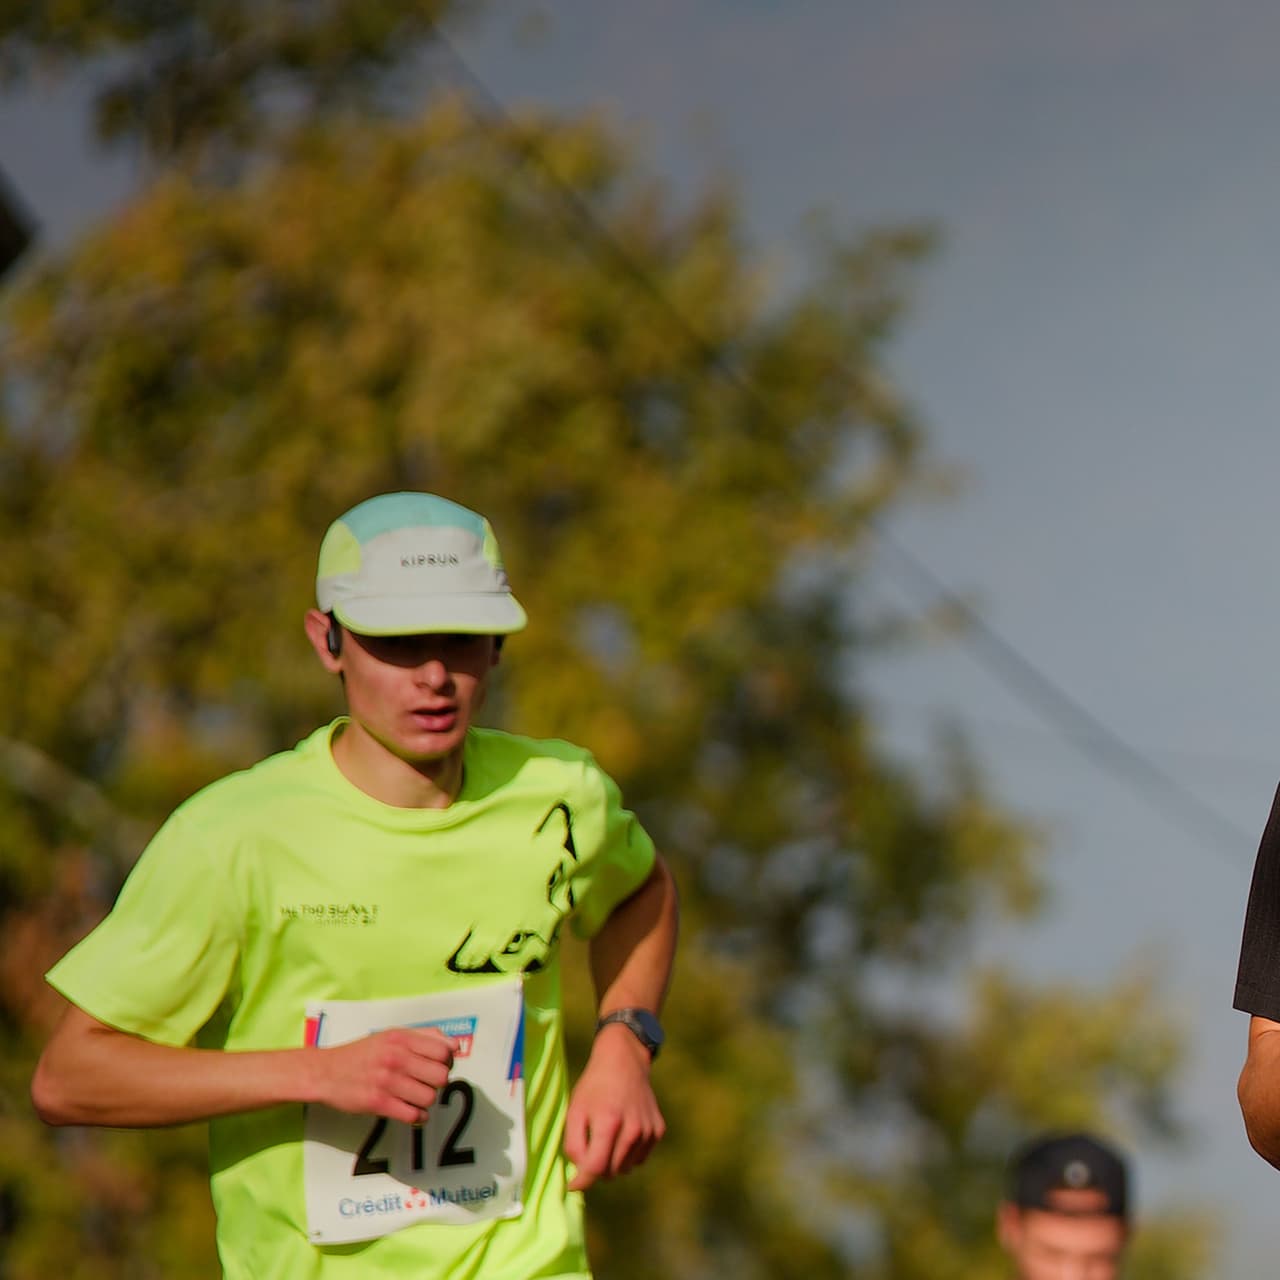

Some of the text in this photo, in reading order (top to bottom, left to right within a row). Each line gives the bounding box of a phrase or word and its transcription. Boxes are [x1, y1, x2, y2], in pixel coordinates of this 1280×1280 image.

[400, 553, 459, 567] KIPRUN
[339, 1180, 499, 1217] Crédit Mutuel
